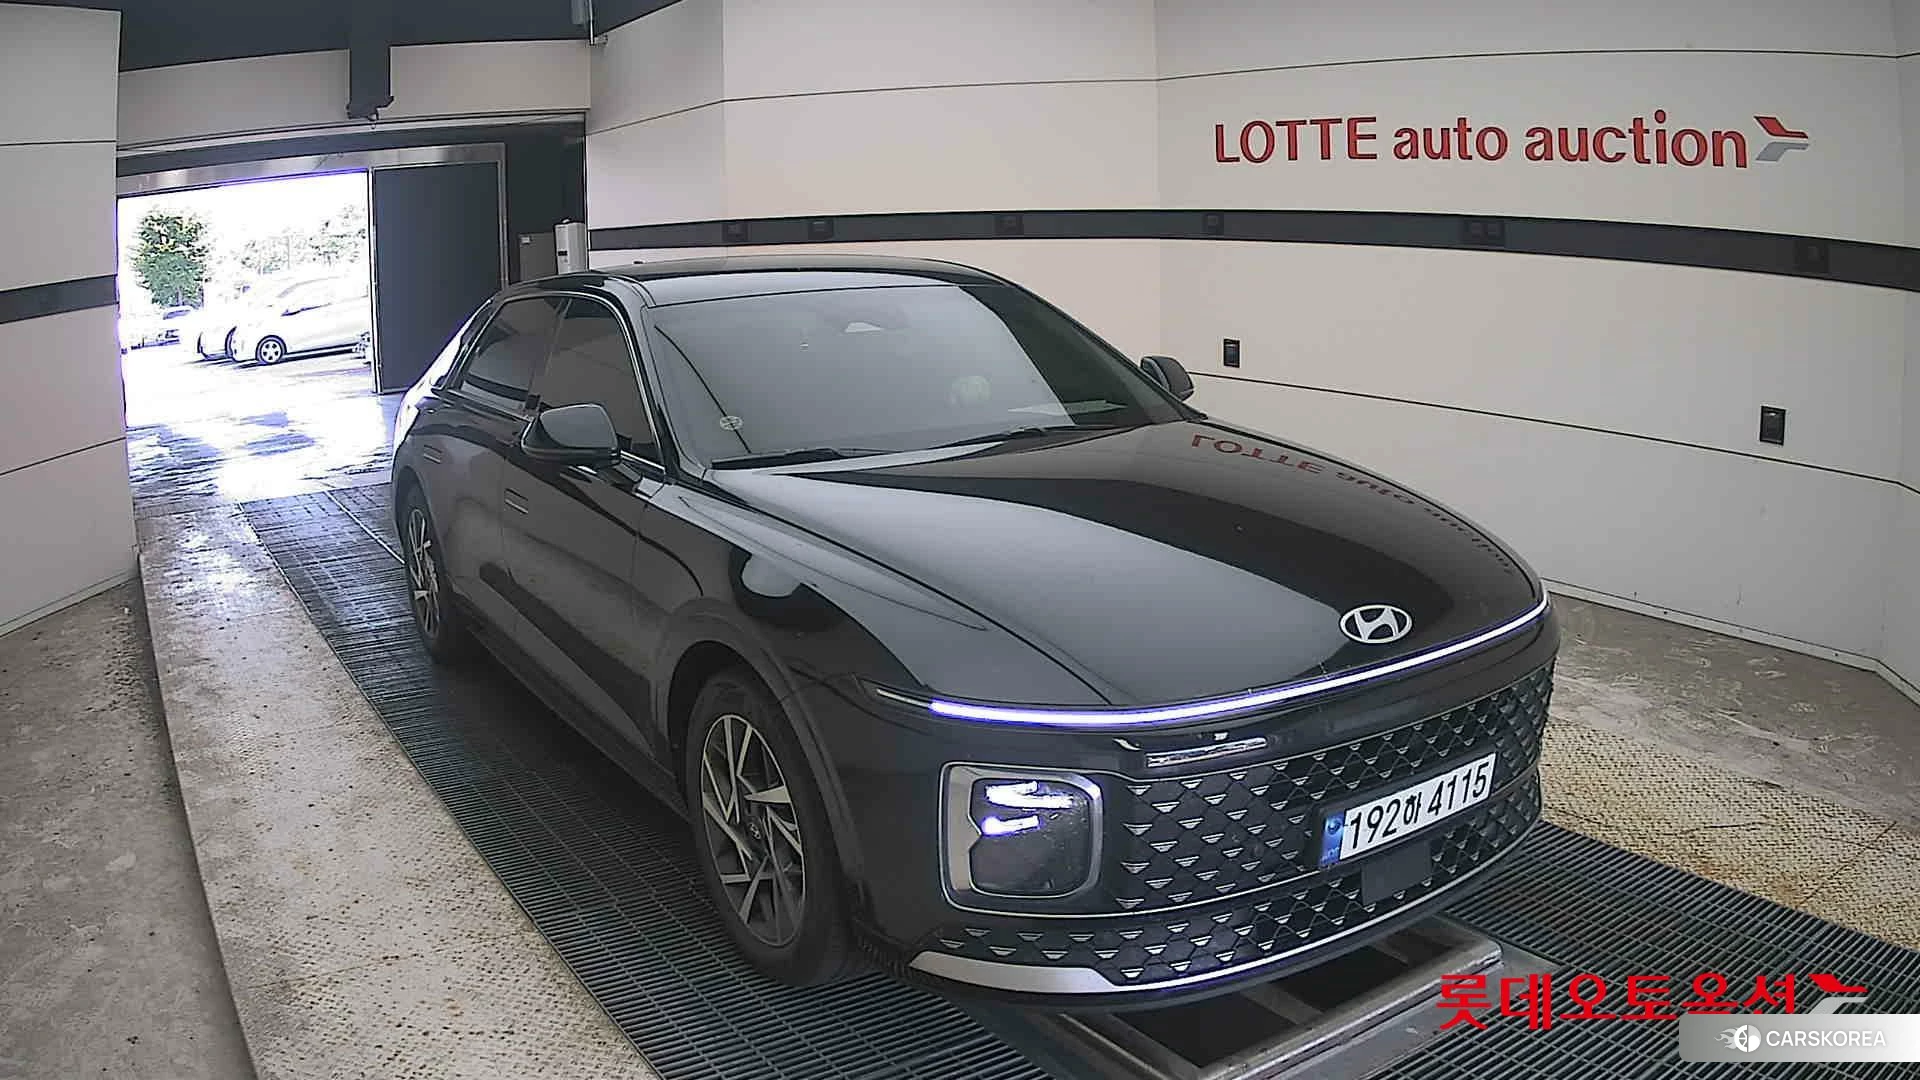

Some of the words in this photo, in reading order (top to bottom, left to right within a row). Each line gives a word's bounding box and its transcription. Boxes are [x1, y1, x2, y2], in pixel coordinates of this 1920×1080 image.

[1215, 116, 1378, 164] LOTTE
[1393, 117, 1509, 163] auto
[1524, 109, 1749, 169] auction
[1351, 791, 1423, 849] 192하
[1427, 761, 1490, 816] 4115
